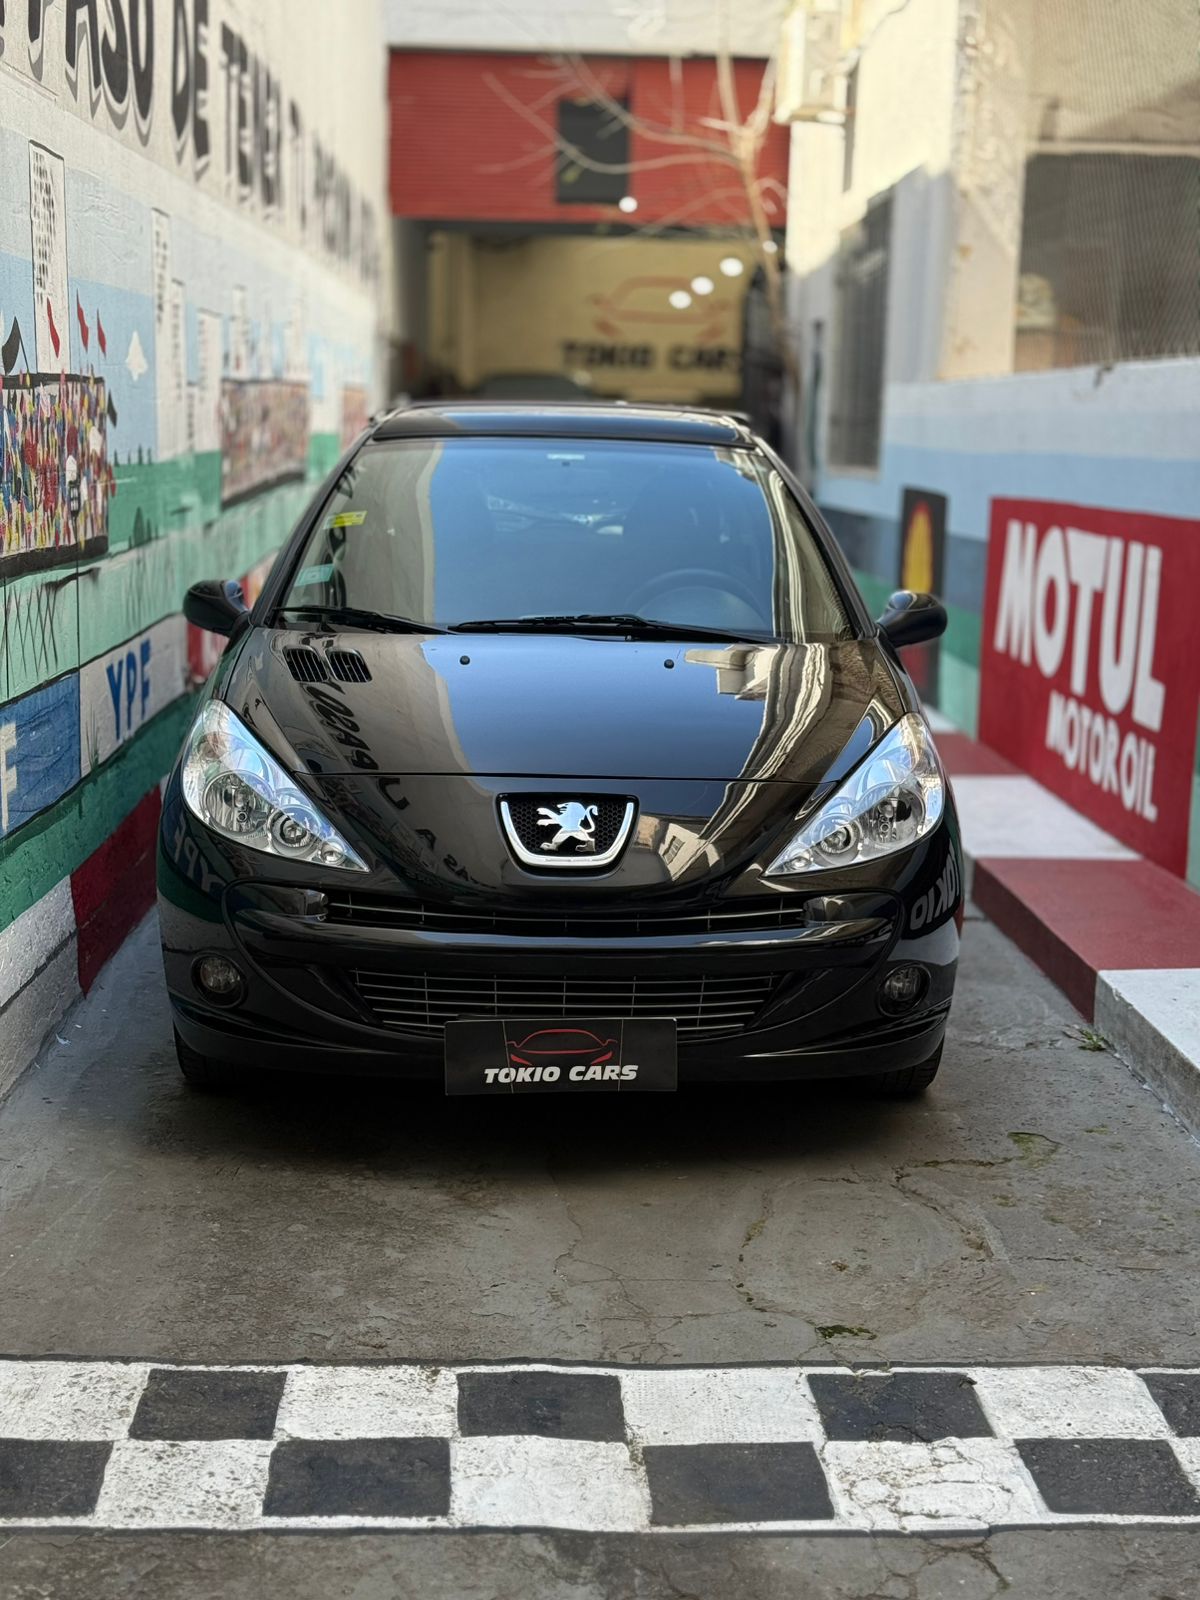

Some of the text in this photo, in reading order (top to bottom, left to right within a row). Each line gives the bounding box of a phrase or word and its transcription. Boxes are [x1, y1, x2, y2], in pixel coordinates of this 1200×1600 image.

[28, 0, 154, 134] ASO
[171, 0, 210, 166] DE
[106, 638, 151, 743] YPF
[994, 519, 1165, 732] MOTUL
[1045, 689, 1158, 822] MOTOR OIL
[484, 1065, 638, 1083] TOKIO CARS
